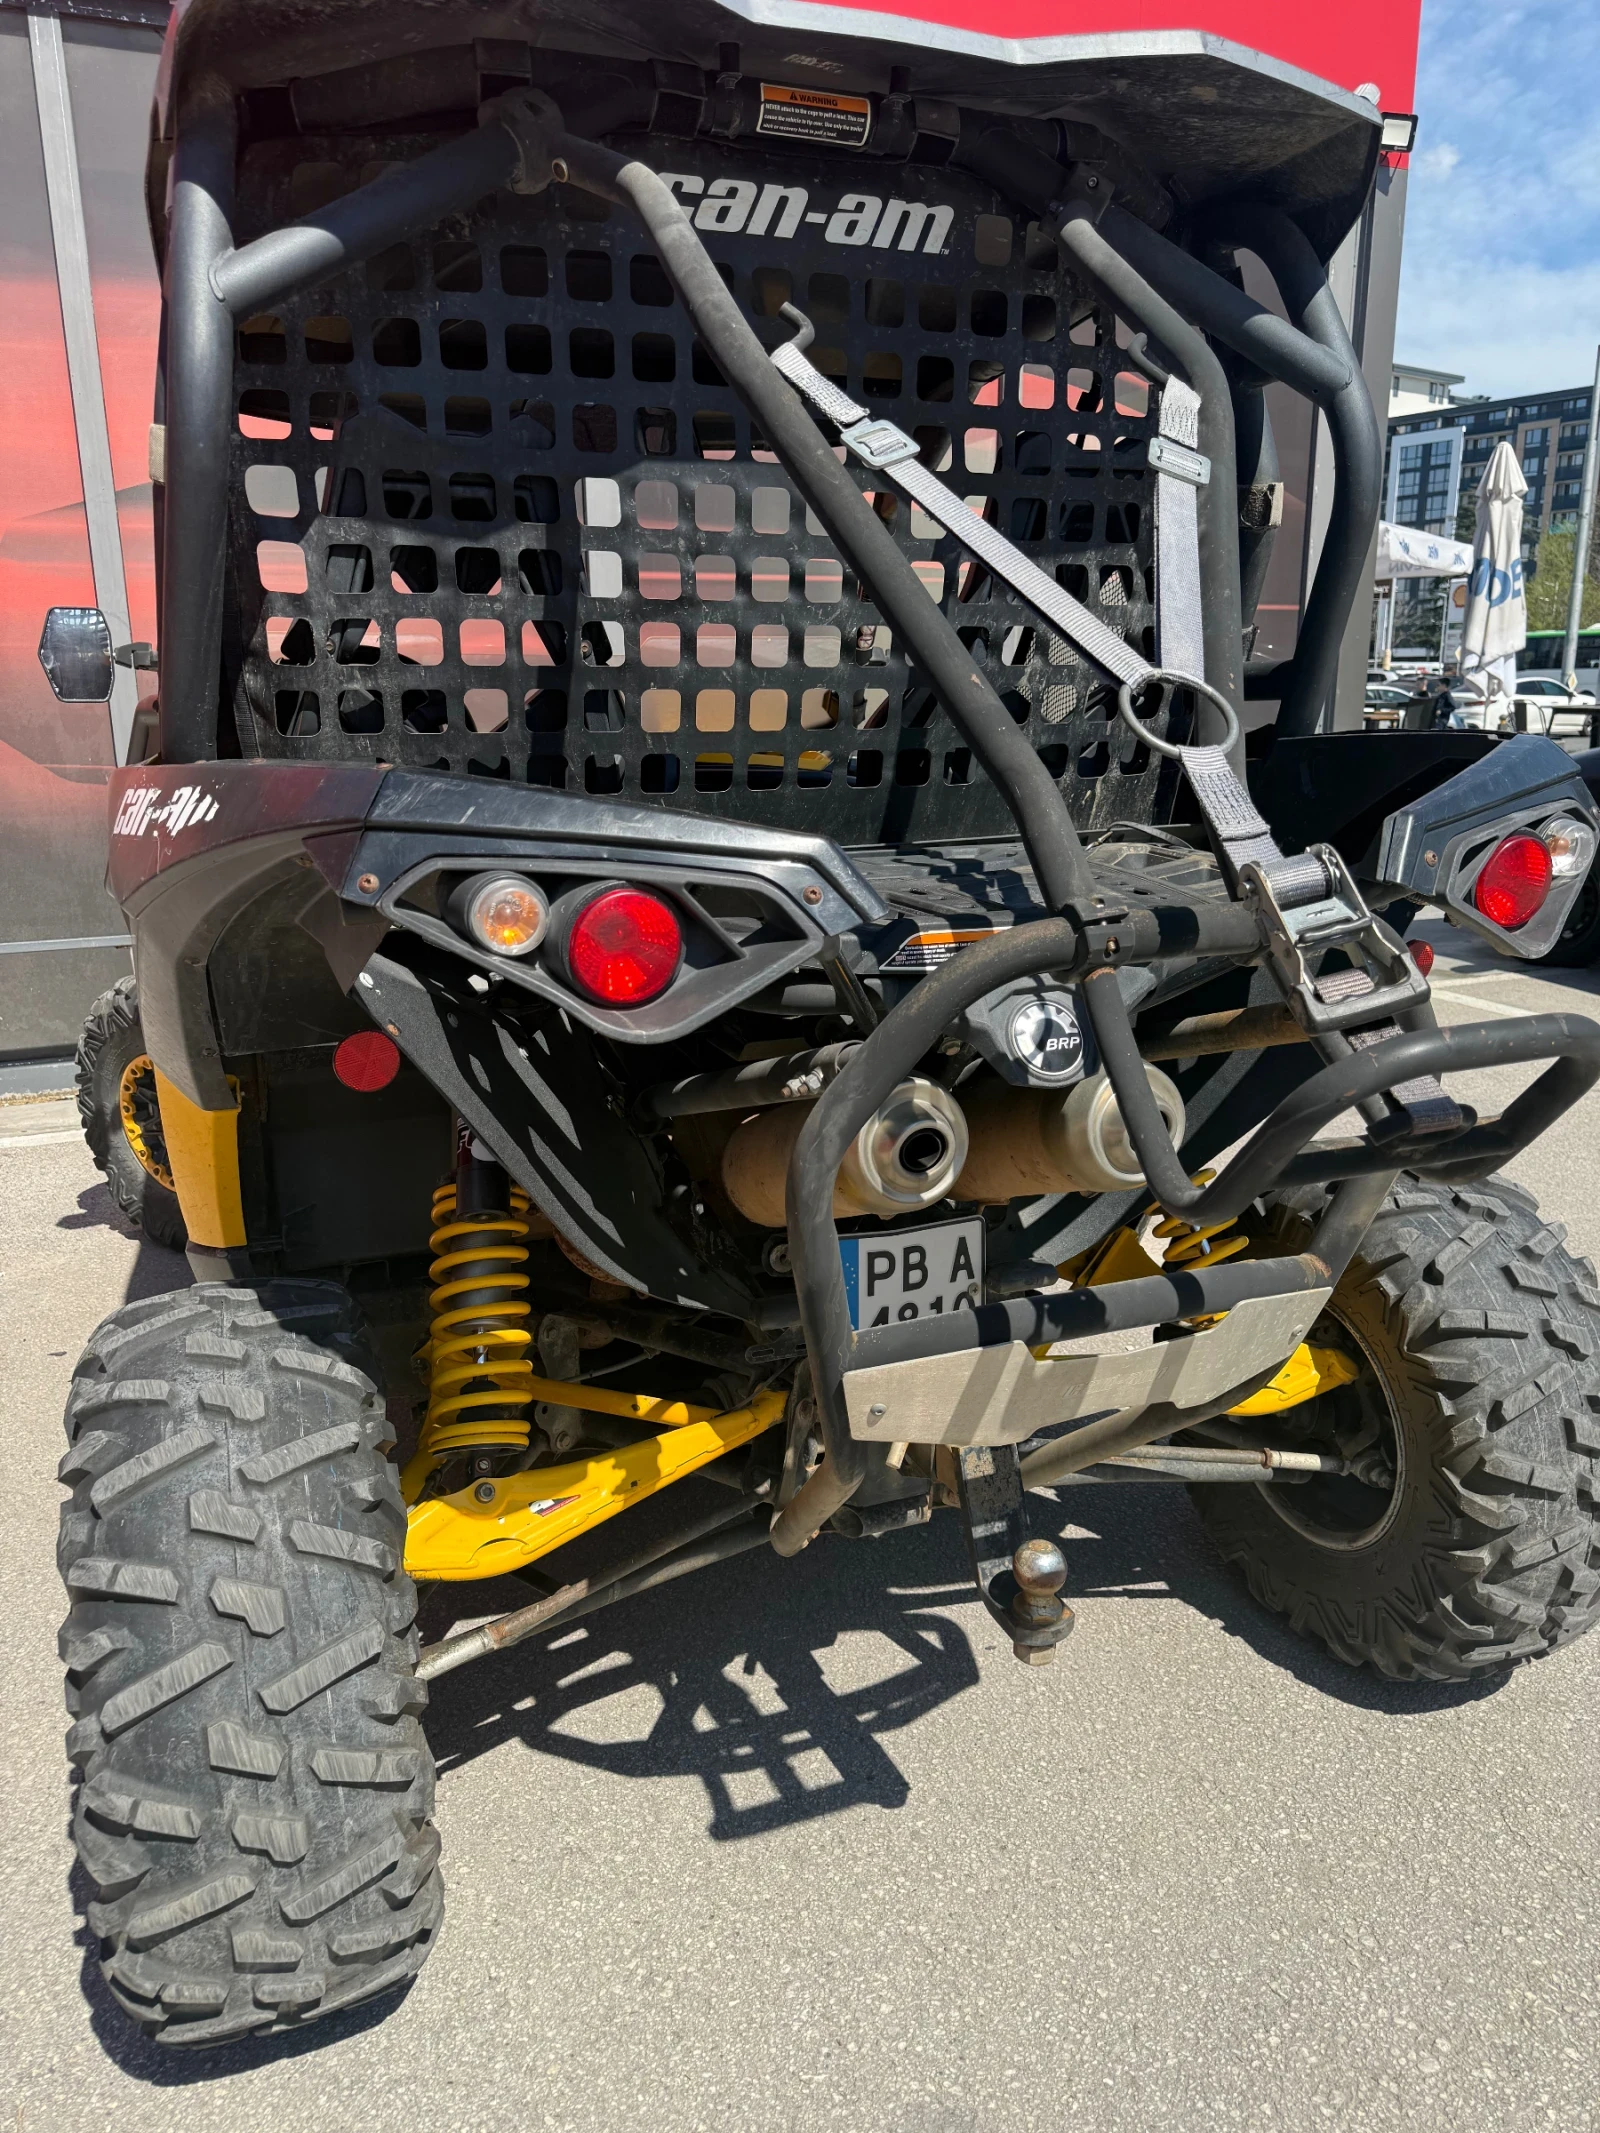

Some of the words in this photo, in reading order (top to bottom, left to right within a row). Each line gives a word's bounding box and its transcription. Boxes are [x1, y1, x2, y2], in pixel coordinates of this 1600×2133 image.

[765, 103, 780, 111] NEVER
[799, 94, 838, 107] WARNING
[657, 172, 954, 254] can-am
[1046, 1036, 1080, 1051] BRP
[867, 1244, 929, 1297] PB
[949, 1236, 975, 1283] A
